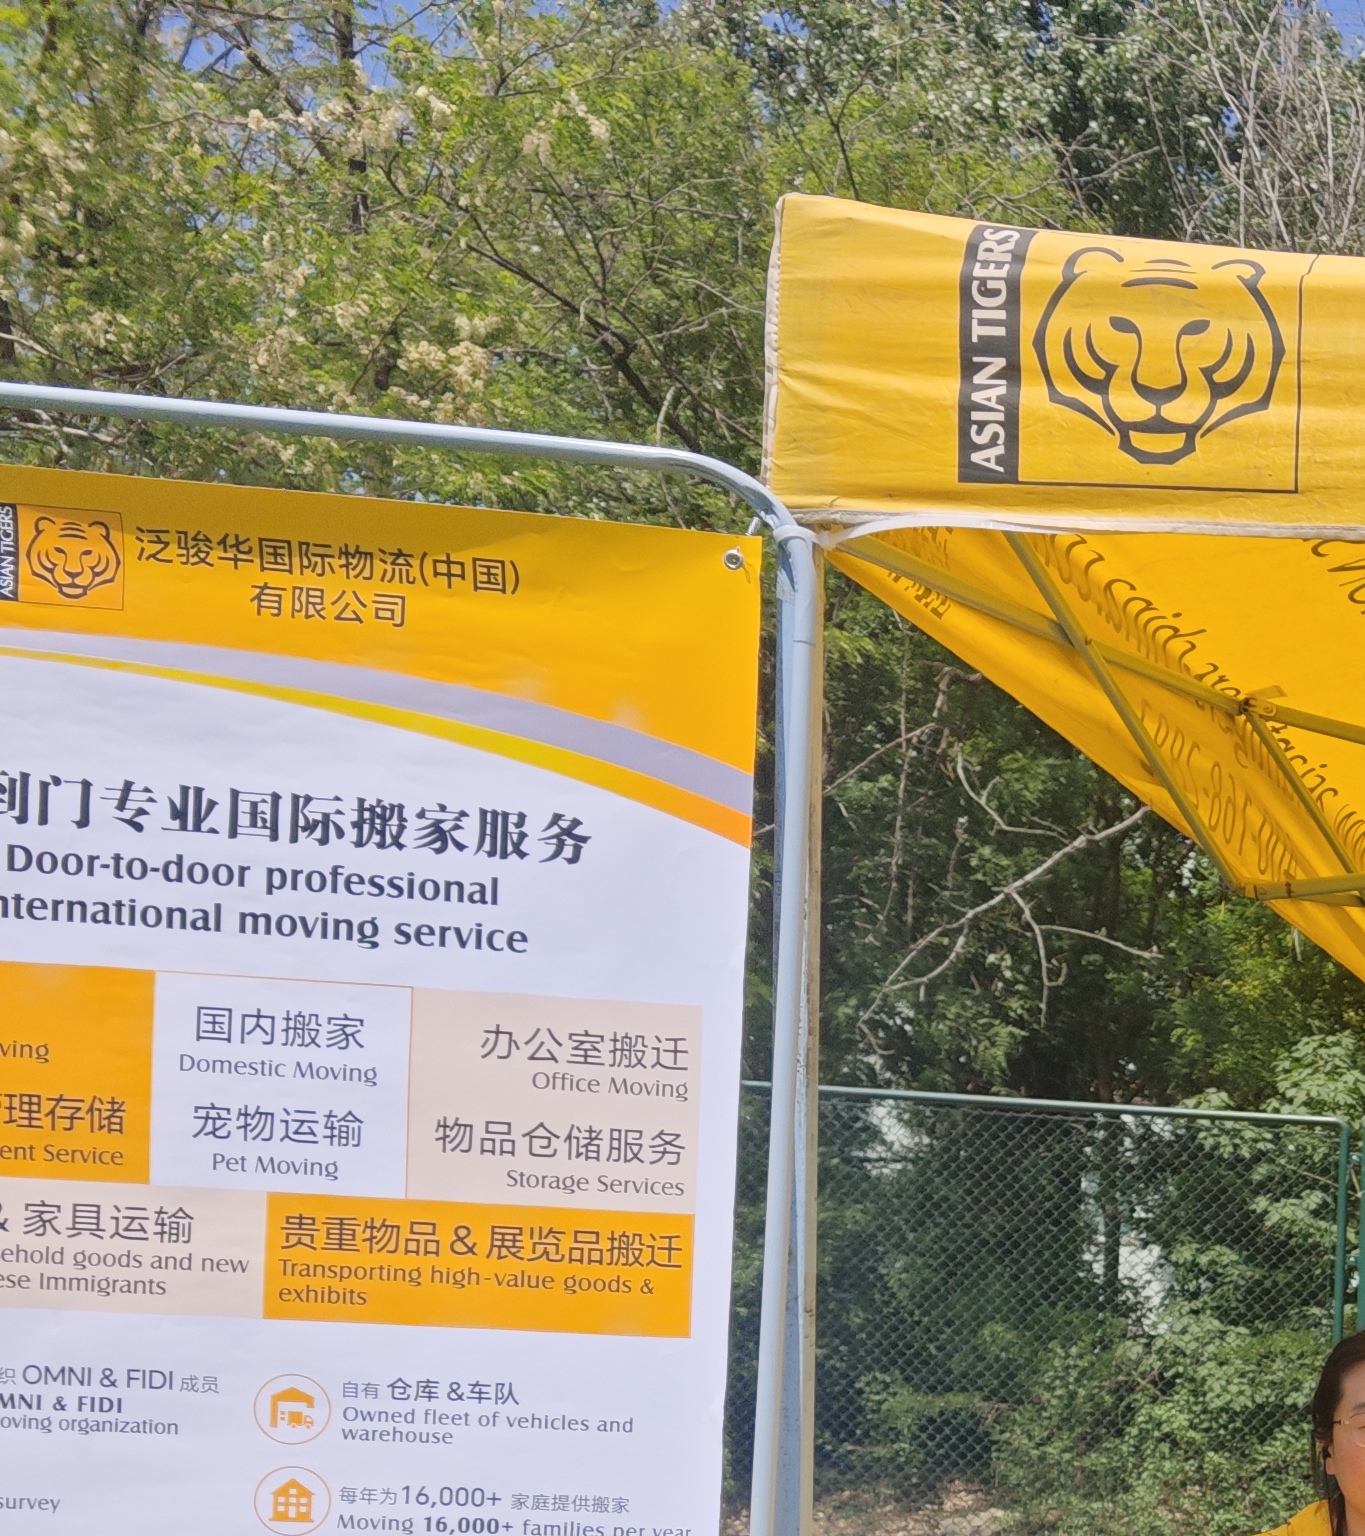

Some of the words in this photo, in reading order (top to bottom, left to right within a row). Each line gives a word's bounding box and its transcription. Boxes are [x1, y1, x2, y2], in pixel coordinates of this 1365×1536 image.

[971, 229, 1022, 344] TIGERS
[969, 357, 1007, 472] ASIAN
[135, 525, 521, 595] 泛骏华国际物流(中国)
[250, 580, 407, 628] 有限公司
[7, 843, 251, 887] Door-to-door
[266, 866, 499, 905] professional
[238, 908, 380, 950] moving
[393, 919, 529, 954] service
[195, 1004, 366, 1051] 国内搬家
[479, 1023, 690, 1073] 办公室搬迁
[178, 1053, 287, 1080] Domestic
[288, 1061, 379, 1087] Moving
[531, 1070, 600, 1096] Office
[607, 1076, 689, 1102] Moving
[0, 1092, 127, 1135] 理存储
[191, 1102, 365, 1149] 宠物运输
[42, 1144, 125, 1166] Service
[433, 1115, 687, 1168] 物品仓储服务
[211, 1152, 249, 1174] Pet
[254, 1154, 339, 1181] Moving
[505, 1170, 590, 1196] Storage
[597, 1173, 686, 1197] Services
[22, 1200, 195, 1245] 家具运输
[73, 1249, 144, 1270] goods
[150, 1253, 194, 1272] and
[201, 1258, 250, 1274] new
[278, 1257, 422, 1287] Transporting
[430, 1263, 555, 1292] high-value
[563, 1270, 632, 1295] goods
[639, 1278, 655, 1295] &
[39, 1271, 168, 1297] Immigrants
[278, 1285, 368, 1308] exhibits
[22, 1364, 92, 1387] OMNI
[99, 1367, 119, 1389] &
[126, 1368, 174, 1391] FIDI
[179, 1374, 220, 1394] 成员
[341, 1380, 380, 1401] 自有
[52, 1395, 67, 1411] &
[77, 1395, 123, 1413] FIDI
[342, 1406, 416, 1425] Owned
[422, 1407, 473, 1426] fleet
[478, 1408, 499, 1427] of
[505, 1410, 590, 1431] vehicles
[597, 1415, 634, 1433] and
[58, 1417, 179, 1435] organization
[341, 1426, 454, 1445] warehouse
[510, 1492, 630, 1515] 家庭提供搬家
[337, 1514, 414, 1536] Moving
[423, 1516, 515, 1536] 16,000+
